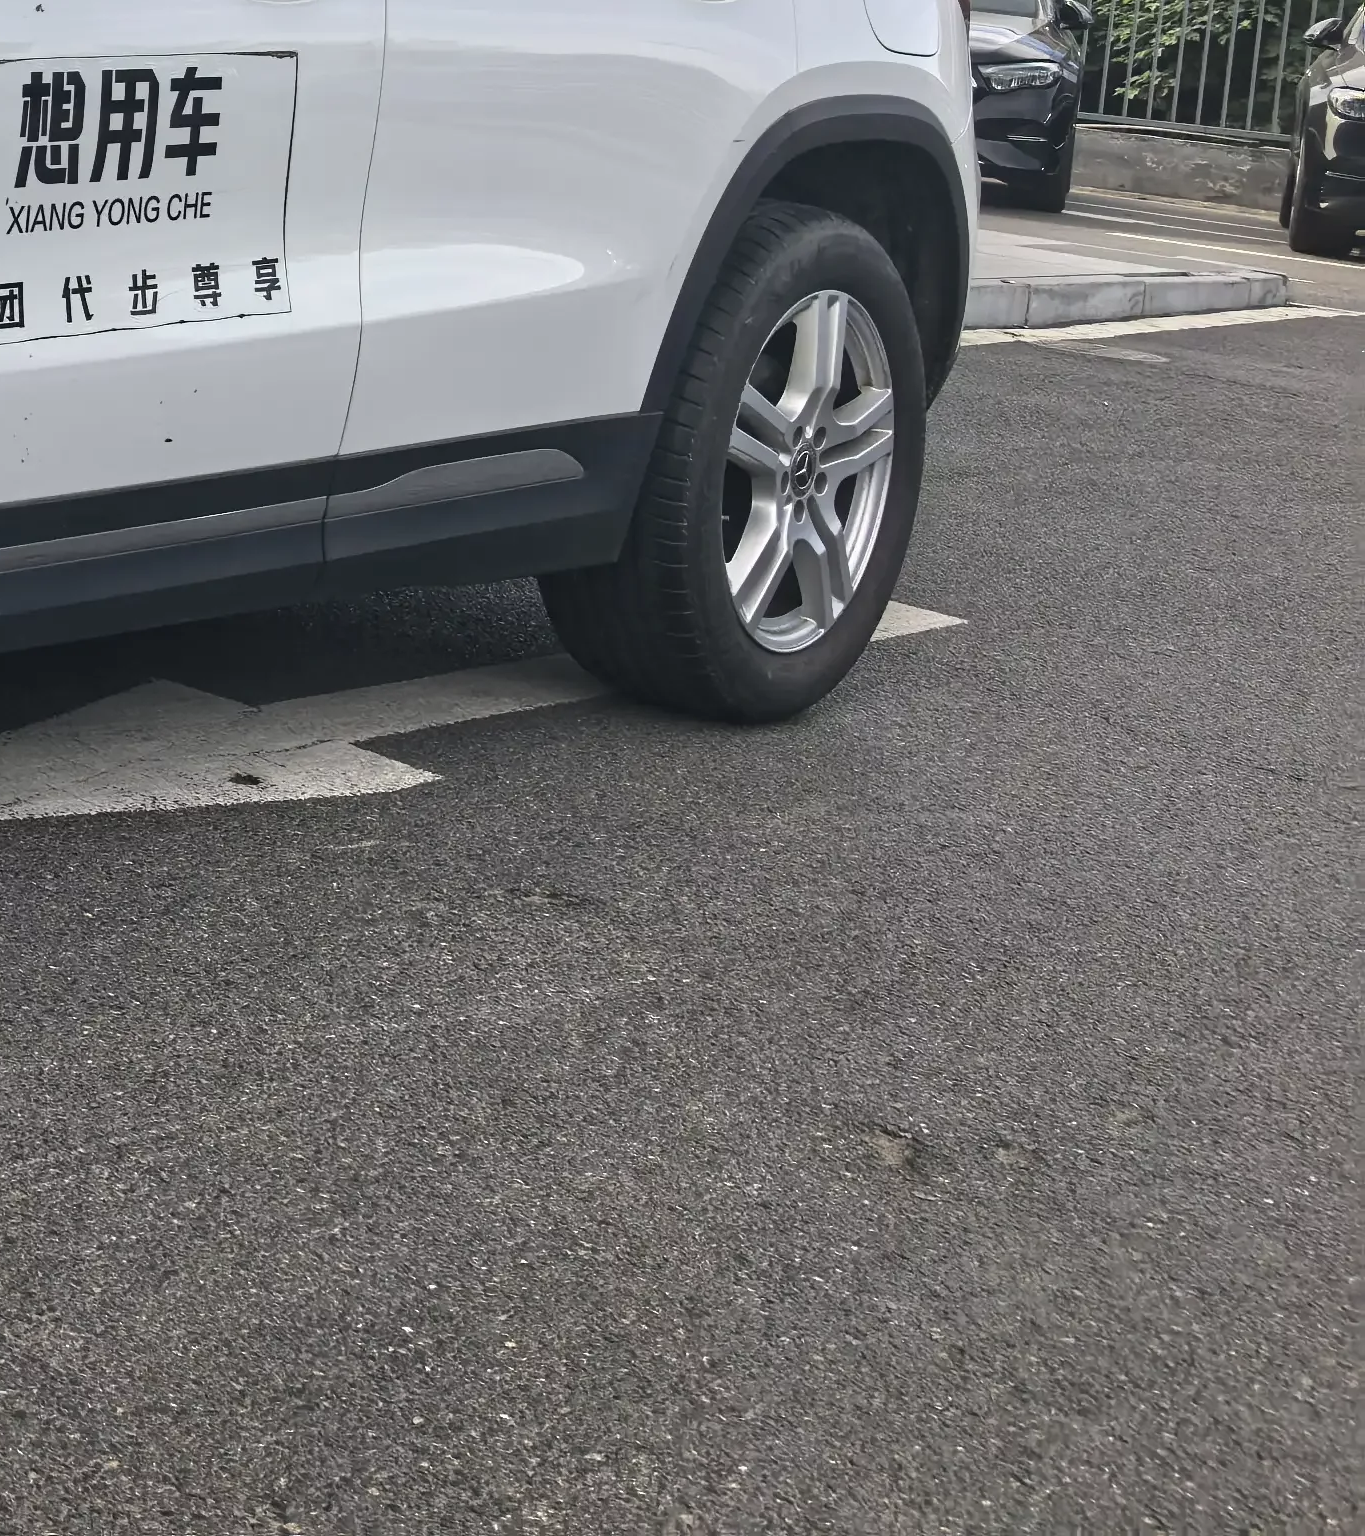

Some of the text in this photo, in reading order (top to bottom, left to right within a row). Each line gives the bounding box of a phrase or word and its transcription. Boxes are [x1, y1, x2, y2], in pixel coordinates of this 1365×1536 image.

[13, 66, 223, 189] 想用车
[5, 191, 213, 235] XIANG YONG CHE
